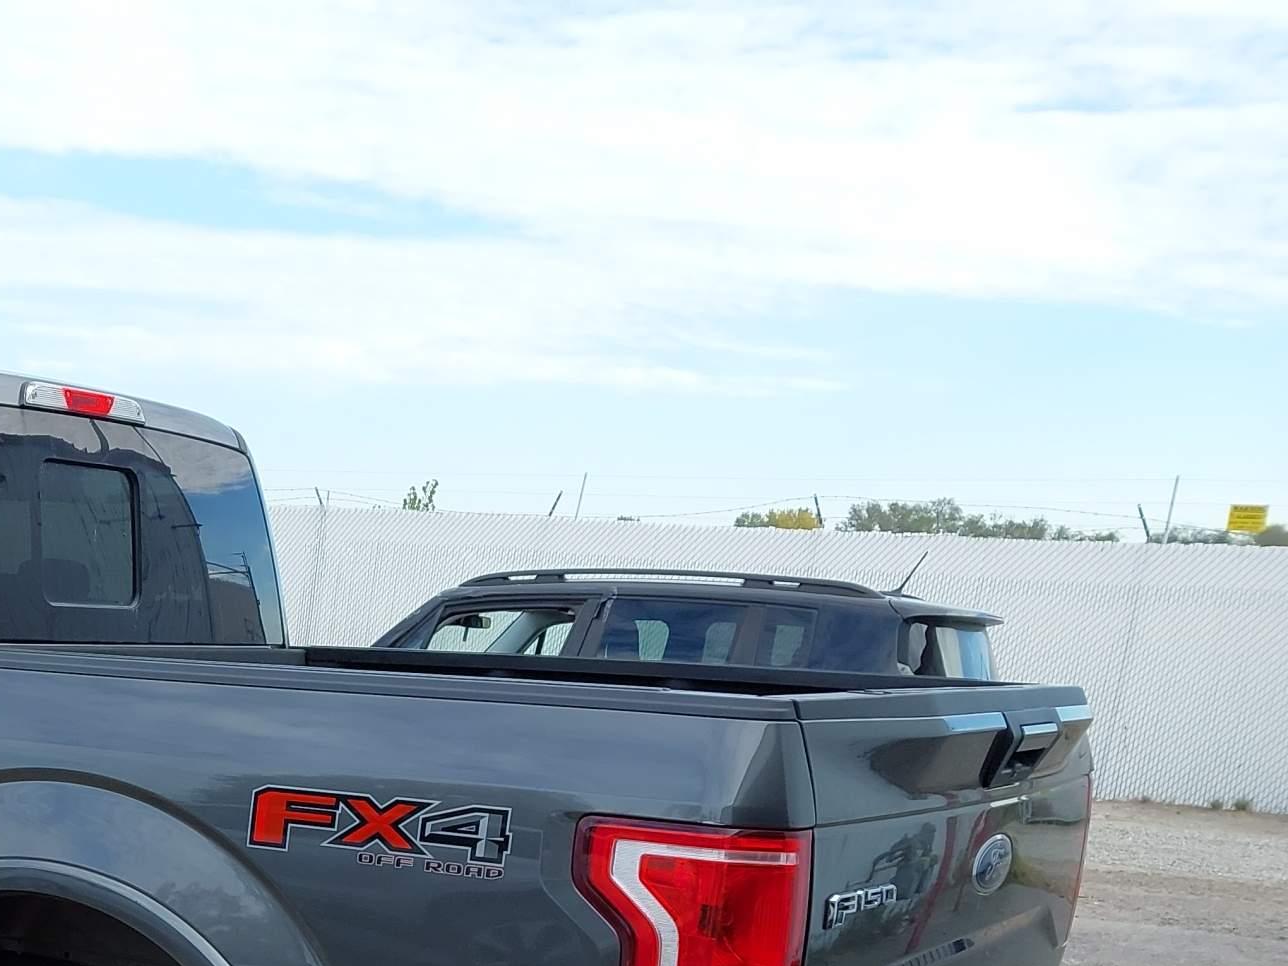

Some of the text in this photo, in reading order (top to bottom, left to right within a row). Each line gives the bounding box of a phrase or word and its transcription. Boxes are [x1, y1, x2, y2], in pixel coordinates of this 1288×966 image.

[247, 784, 512, 867] FX4
[357, 852, 505, 880] OFF ROAD
[827, 884, 897, 928] F150
